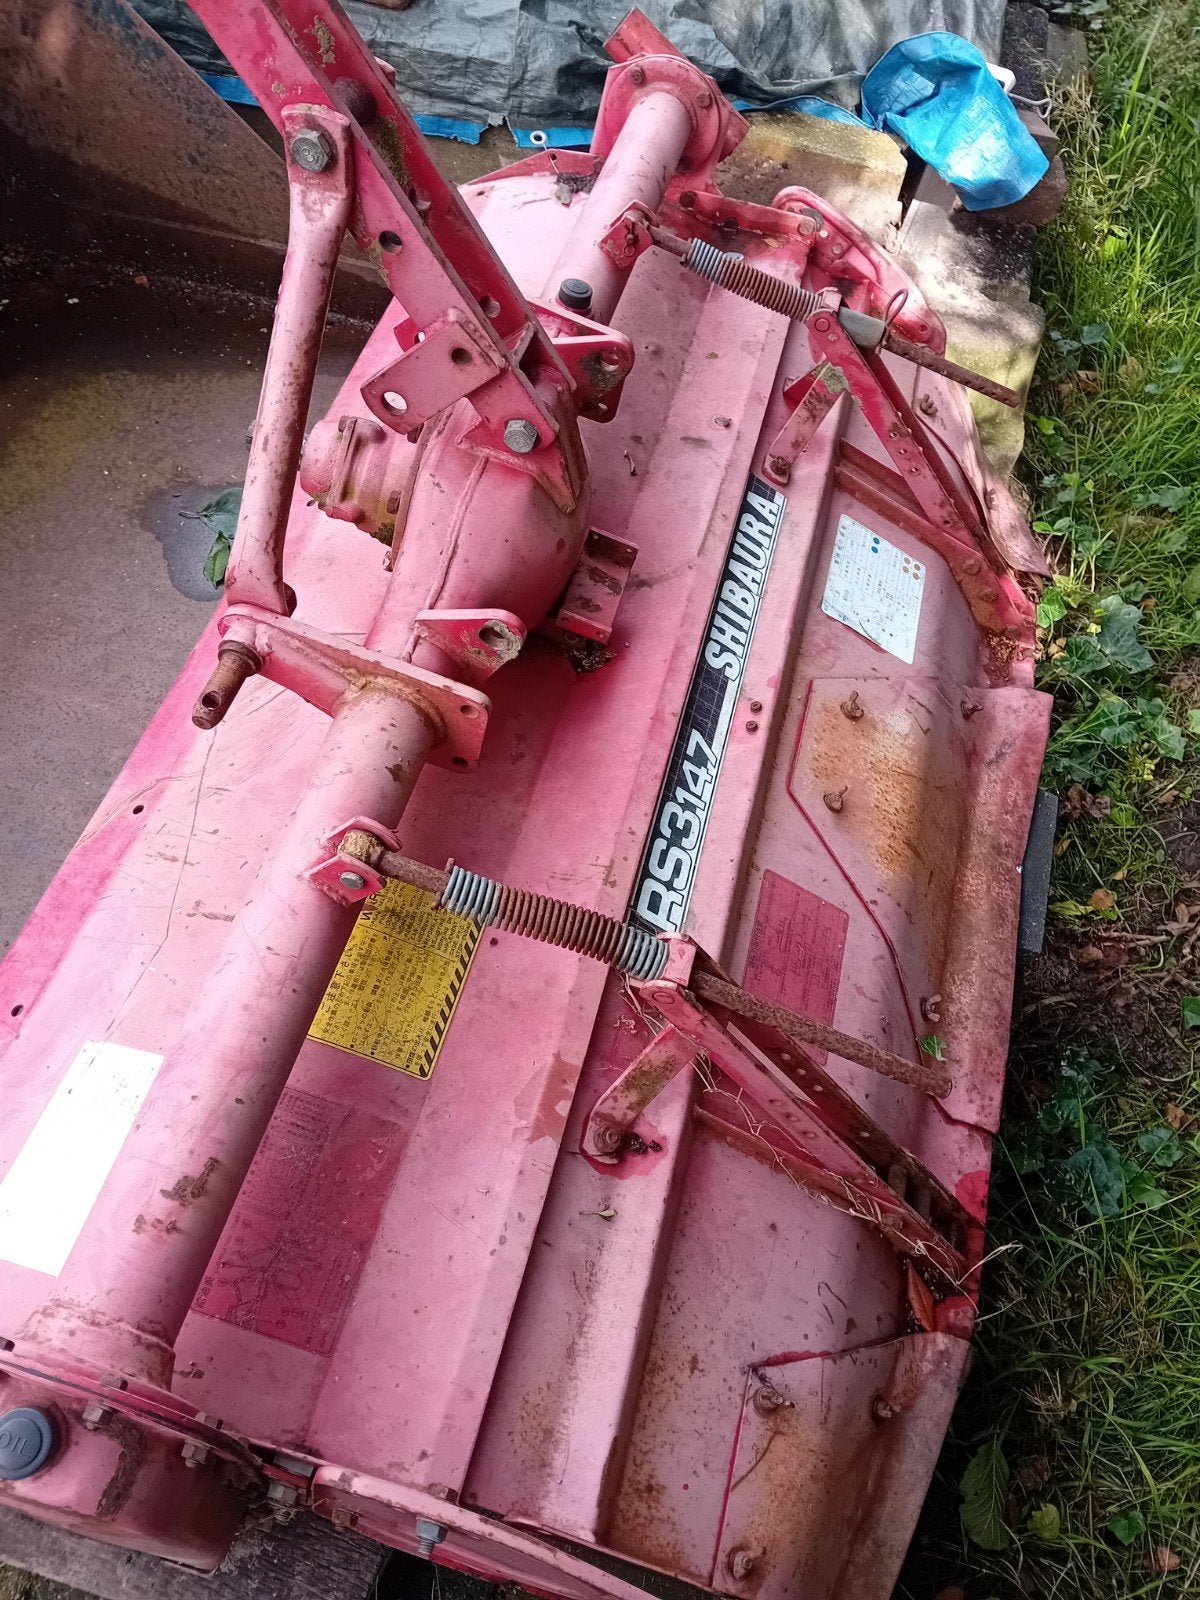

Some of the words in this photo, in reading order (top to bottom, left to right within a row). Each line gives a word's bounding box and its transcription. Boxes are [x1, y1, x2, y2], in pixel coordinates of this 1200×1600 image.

[636, 728, 719, 932] RS3147
[705, 490, 781, 682] SHIBAURA
[0, 1432, 31, 1457] OIL
